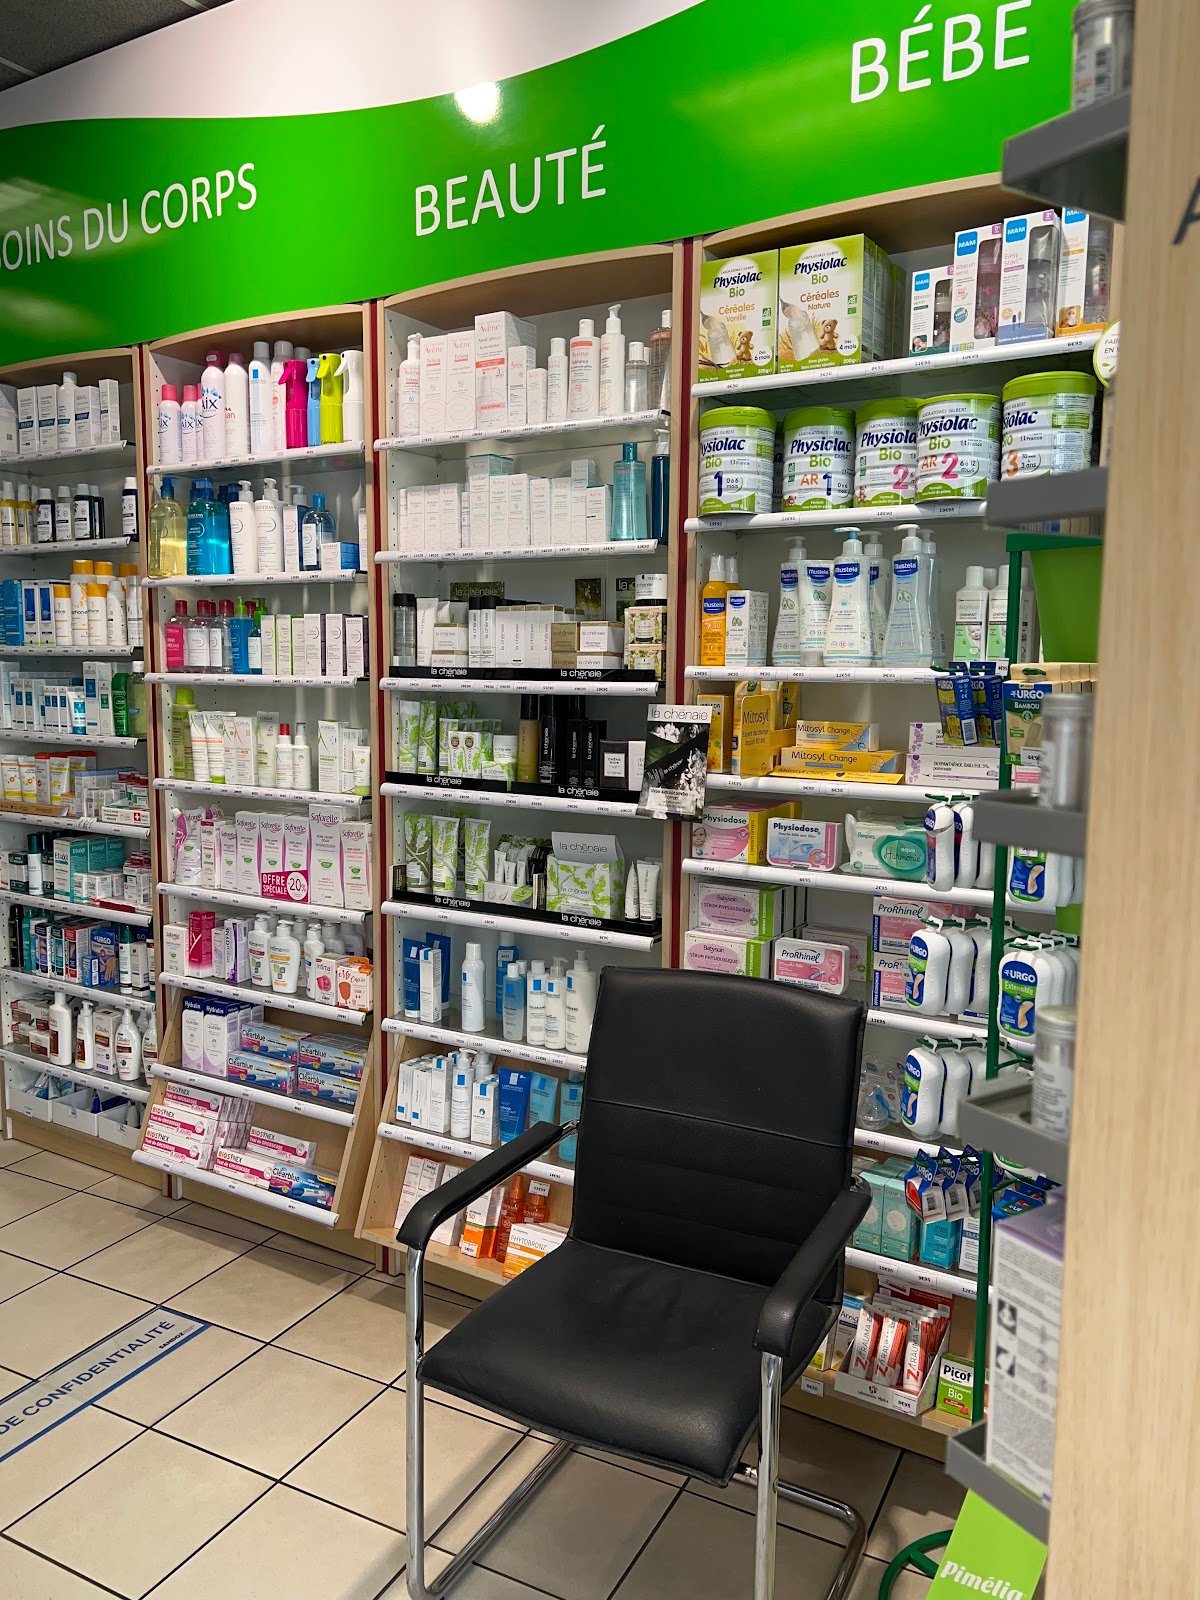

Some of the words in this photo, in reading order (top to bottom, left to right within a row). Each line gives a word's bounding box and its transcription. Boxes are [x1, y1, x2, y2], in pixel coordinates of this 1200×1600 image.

[416, 124, 606, 236] BEAUTÉ
[0, 215, 73, 271] OINS
[83, 203, 128, 252] DU
[141, 162, 258, 235] CORPS
[1007, 226, 1025, 236] MAM
[958, 240, 976, 249] MAM
[794, 257, 847, 275] Physiolac
[713, 270, 762, 288] Physiolac
[811, 274, 828, 284] Bio
[915, 278, 929, 286] MAM
[729, 287, 745, 298] Bio
[800, 290, 840, 303] Céréales
[719, 302, 755, 315] Céréales
[808, 302, 831, 310] Nature
[726, 314, 746, 322] Vanille
[1003, 410, 1038, 430] siolac
[861, 428, 917, 448] Physiola
[929, 436, 951, 451] Bio
[701, 438, 745, 457] ysiolac
[790, 438, 851, 455] Physiolac
[809, 454, 831, 468] Bio
[879, 447, 902, 461] Bio
[705, 456, 722, 469] Bio
[921, 455, 937, 469] AR
[941, 452, 959, 480] 2
[1006, 450, 1019, 477] 3
[714, 471, 723, 497] 1
[800, 473, 819, 486] AR
[823, 472, 832, 496] 1
[892, 464, 909, 490] 2
[834, 566, 858, 574] Mustela
[1016, 690, 1043, 699] URGO
[1014, 701, 1040, 709] BAMBOU
[651, 708, 660, 718] la
[742, 709, 769, 725] Mitosyl
[797, 724, 826, 734] Mitosyl
[827, 726, 850, 735] Change
[791, 751, 826, 761] Mitosyl
[829, 753, 857, 763] Change
[703, 813, 747, 824] Physiodose
[773, 823, 820, 833] Physiodose
[884, 846, 921, 863] Harmonie
[263, 874, 285, 886] OFFRE
[263, 885, 287, 895] SPÉCIALE
[878, 902, 923, 918] ProRhinel
[781, 948, 821, 964] ProRhinel
[1010, 969, 1036, 983] URGO
[1005, 981, 1034, 996] Extensible
[272, 1167, 300, 1183] Clearblue
[510, 1235, 547, 1251] PHYTOBRONZ
[840, 1310, 859, 1323] Arnig
[159, 1332, 184, 1349] SANDOZ
[0, 1415, 25, 1435] DE
[22, 1320, 175, 1417] CONFIDENTIALITÉ
[943, 1364, 972, 1382] Picot
[947, 1387, 964, 1401] Bio
